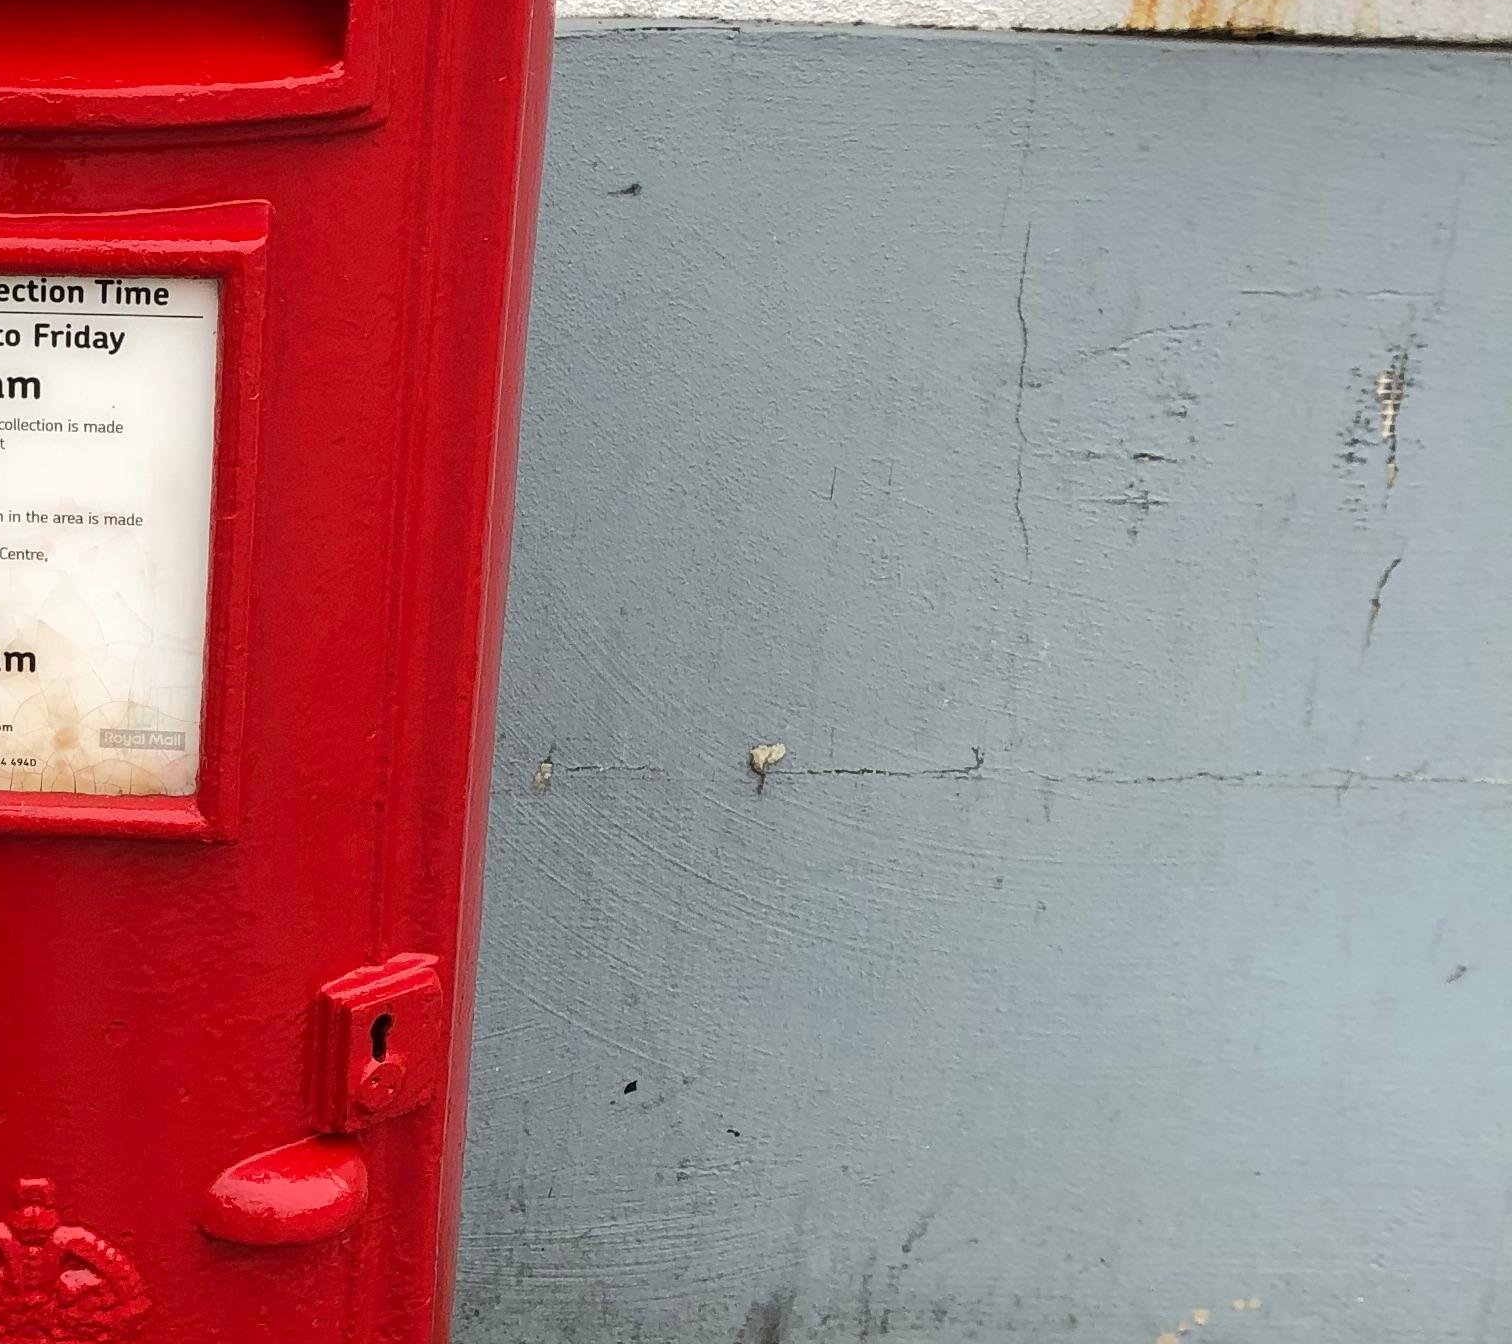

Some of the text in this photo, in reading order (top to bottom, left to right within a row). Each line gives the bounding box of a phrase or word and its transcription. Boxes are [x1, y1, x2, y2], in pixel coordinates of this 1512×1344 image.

[94, 279, 169, 306] Time
[34, 322, 125, 355] Friday
[67, 418, 78, 432] is
[83, 419, 123, 433] made
[8, 509, 20, 522] in
[25, 510, 48, 523] the
[52, 513, 83, 524] area
[88, 511, 99, 524] is
[103, 512, 143, 526] made
[0, 546, 47, 562] Centre,
[104, 731, 181, 747] Royal Mail
